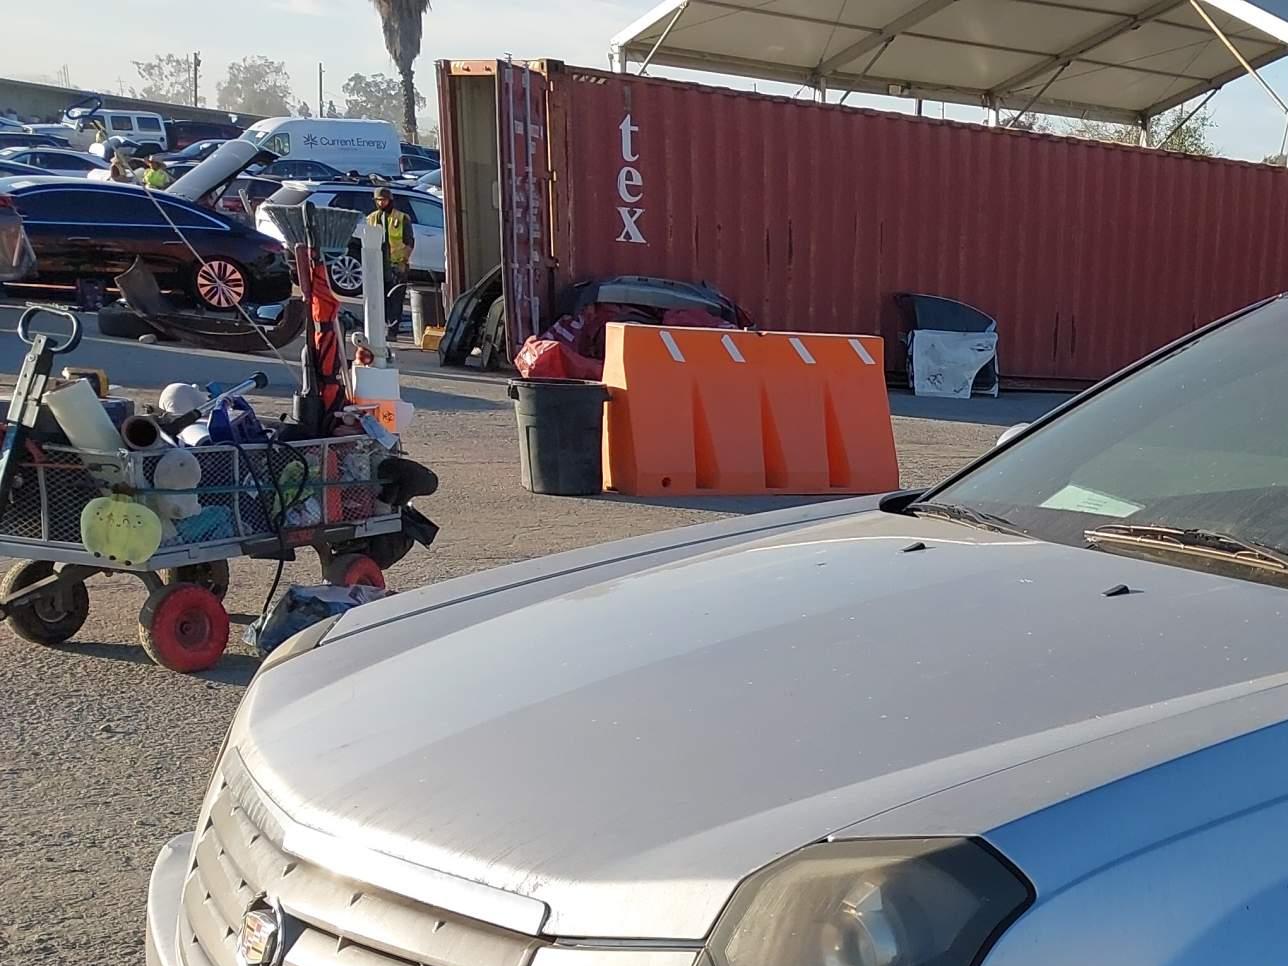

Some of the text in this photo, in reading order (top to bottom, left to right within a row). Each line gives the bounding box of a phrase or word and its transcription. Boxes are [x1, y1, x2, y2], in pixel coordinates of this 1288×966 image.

[320, 136, 387, 150] Current Energy
[615, 113, 647, 243] tex
